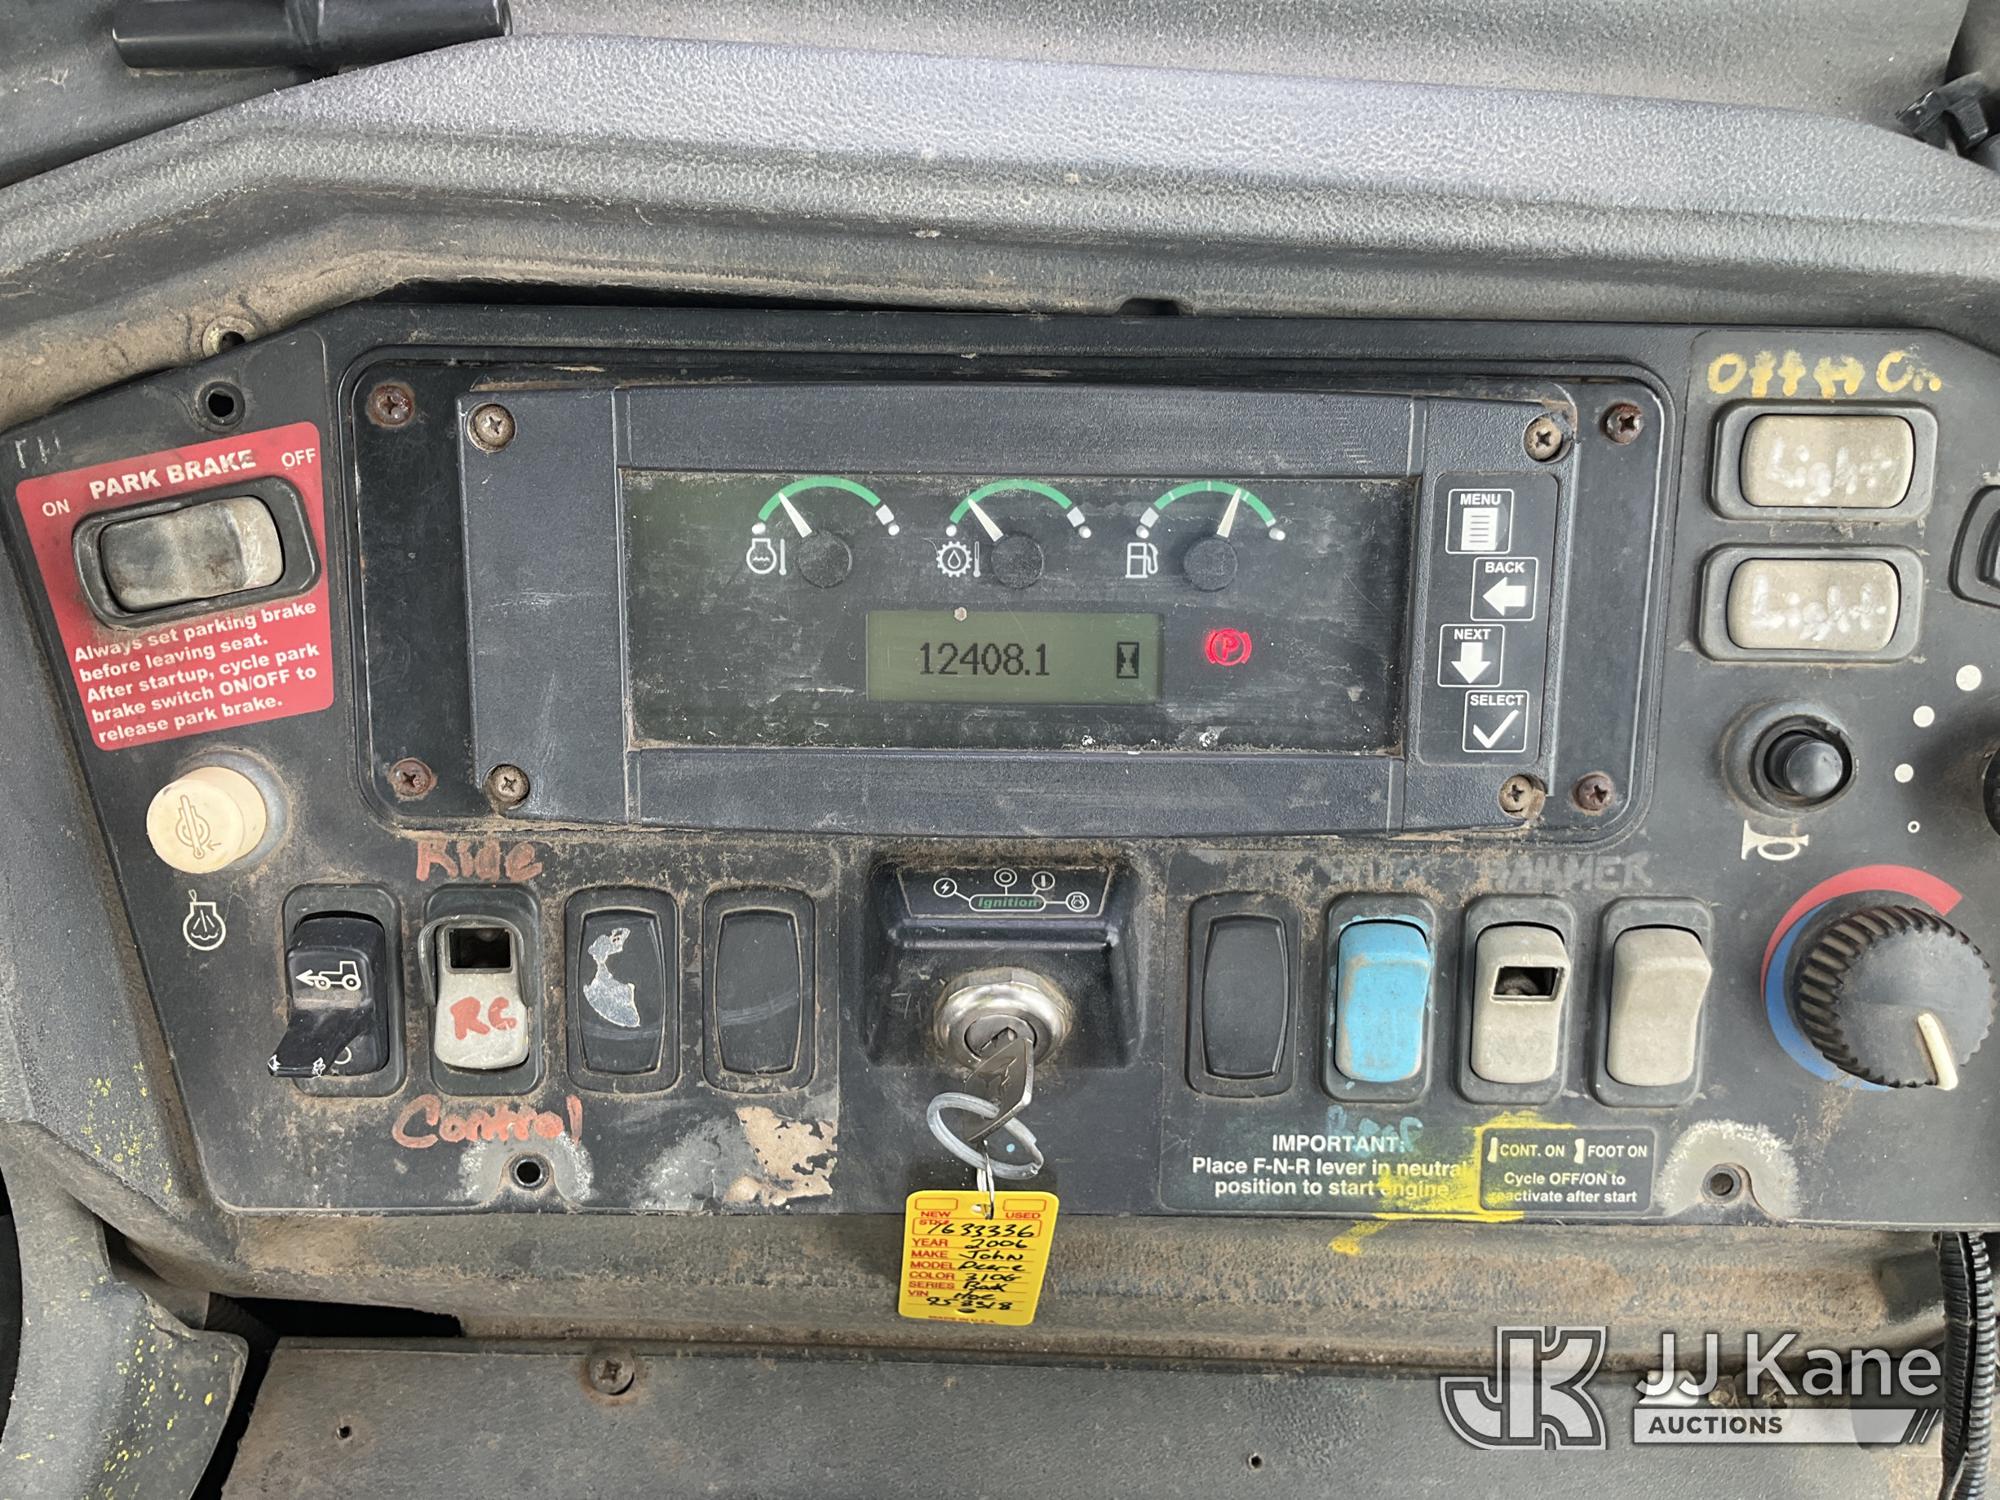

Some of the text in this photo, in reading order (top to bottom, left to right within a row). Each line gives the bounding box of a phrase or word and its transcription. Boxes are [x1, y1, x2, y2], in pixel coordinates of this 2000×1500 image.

[281, 448, 316, 470] OFF
[89, 449, 257, 500] PARK BRAKE
[1460, 493, 1501, 506] MENU
[42, 499, 71, 518] ON
[1485, 561, 1526, 574] BACK
[75, 602, 317, 663] Always set parking brake
[1454, 628, 1492, 641] NEXT
[79, 632, 268, 682] before leaving seat.
[919, 641, 1051, 677] 12408.1
[87, 642, 320, 704] After startup, cycle park
[92, 665, 317, 724] brake switch ON/OFF to
[1470, 694, 1524, 706] SELECT
[98, 694, 283, 743] release park brake.
[416, 841, 543, 882] Ride
[977, 896, 1038, 911] Ignition
[392, 1094, 584, 1148] Control
[1272, 1134, 1407, 1152] IMPORTANT:
[1500, 1144, 1565, 1157] CONT. ON
[1587, 1145, 1648, 1158] FOOT ON
[1192, 1157, 1248, 1174] Place
[1253, 1158, 1310, 1174] F-N-R
[1316, 1158, 1370, 1175] lever
[1372, 1159, 1391, 1176] in
[1504, 1172, 1626, 1187] Cycle OFF/ON to
[1215, 1178, 1297, 1198] position
[1303, 1179, 1323, 1195] to
[1328, 1180, 1375, 1196] start
[1488, 1190, 1638, 1203] activate after start
[912, 1238, 949, 1247] YEAR
[964, 1238, 1028, 1249] 2006
[911, 1250, 949, 1258] MAKE
[910, 1261, 956, 1270] MODEL
[909, 1271, 955, 1280] COLOR
[909, 1281, 955, 1289] SERIES
[908, 1289, 929, 1297] VIN
